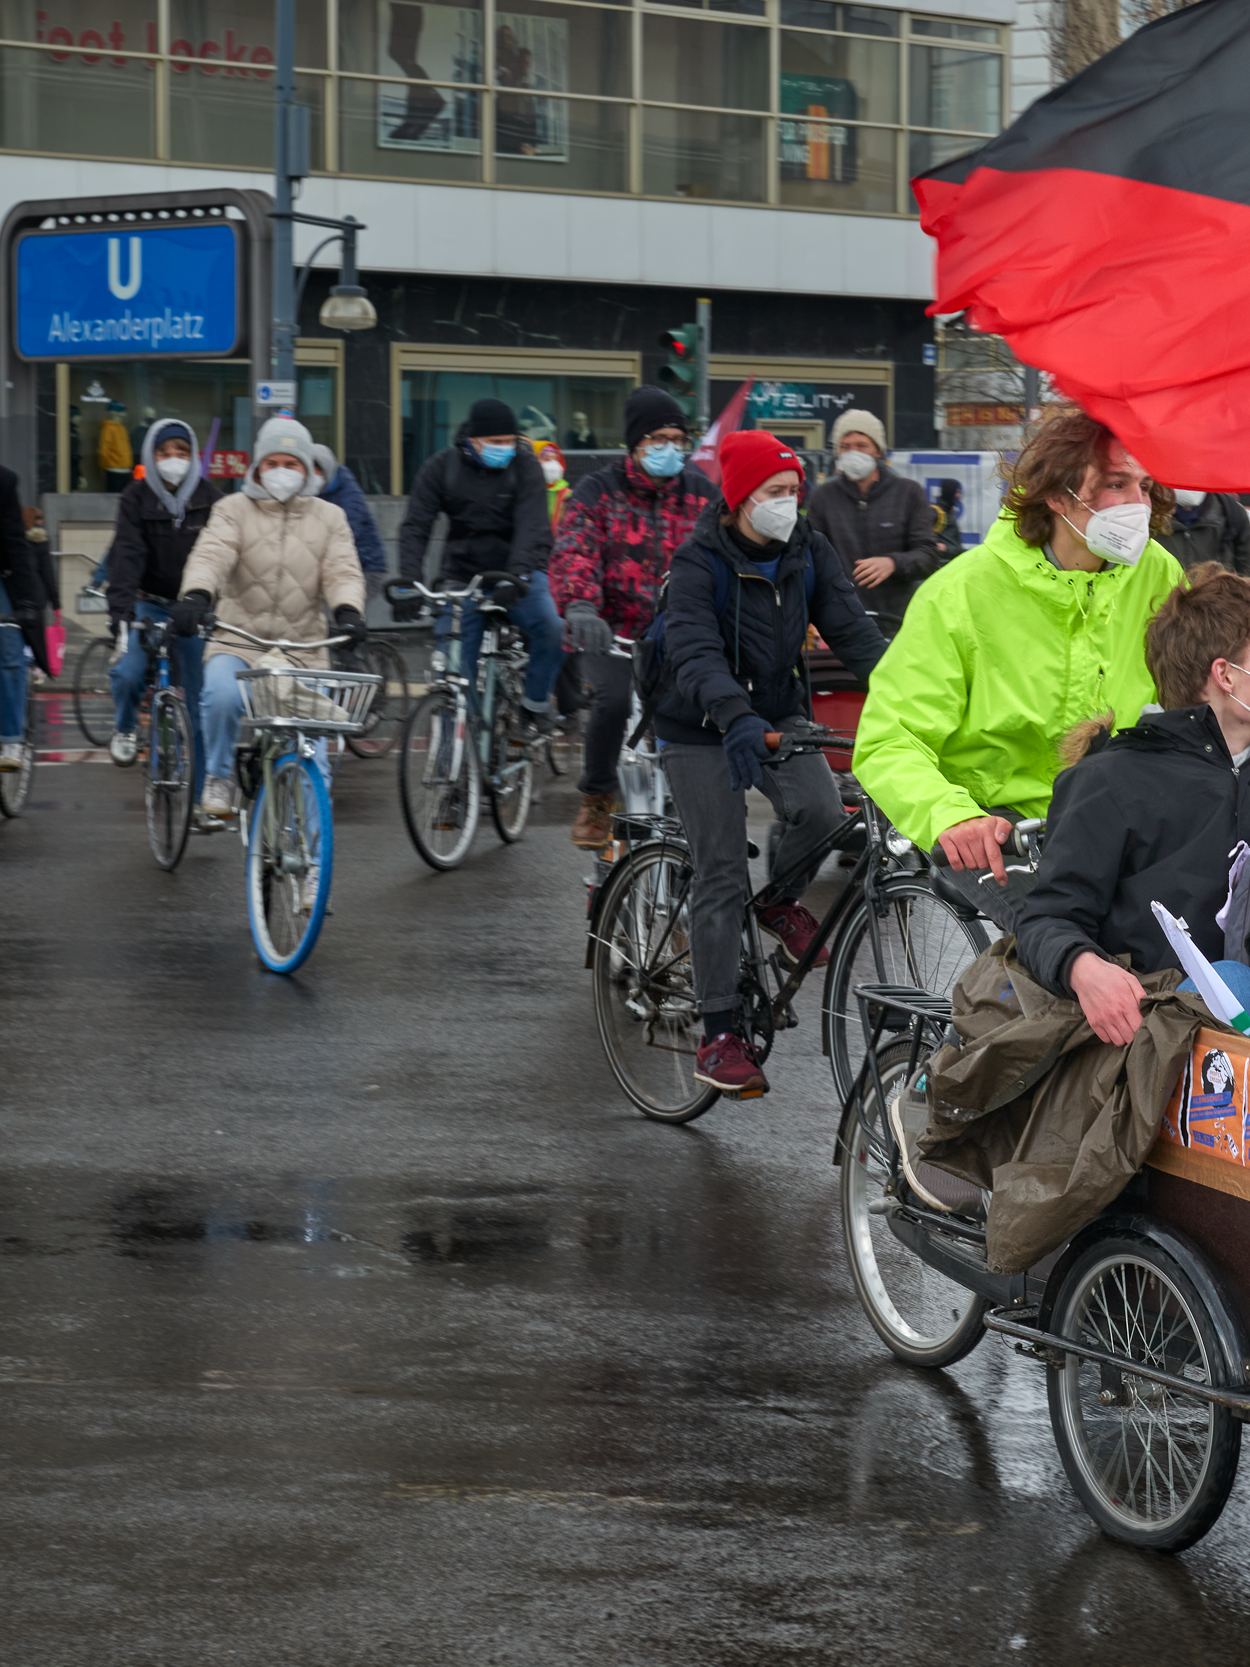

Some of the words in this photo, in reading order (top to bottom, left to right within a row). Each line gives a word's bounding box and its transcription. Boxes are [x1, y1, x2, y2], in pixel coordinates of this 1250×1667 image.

[146, 22, 275, 78] locke
[107, 236, 142, 300] U
[48, 307, 204, 349] Alexanderplatz
[1192, 1094, 1224, 1104] KLIMASCHUTZ
